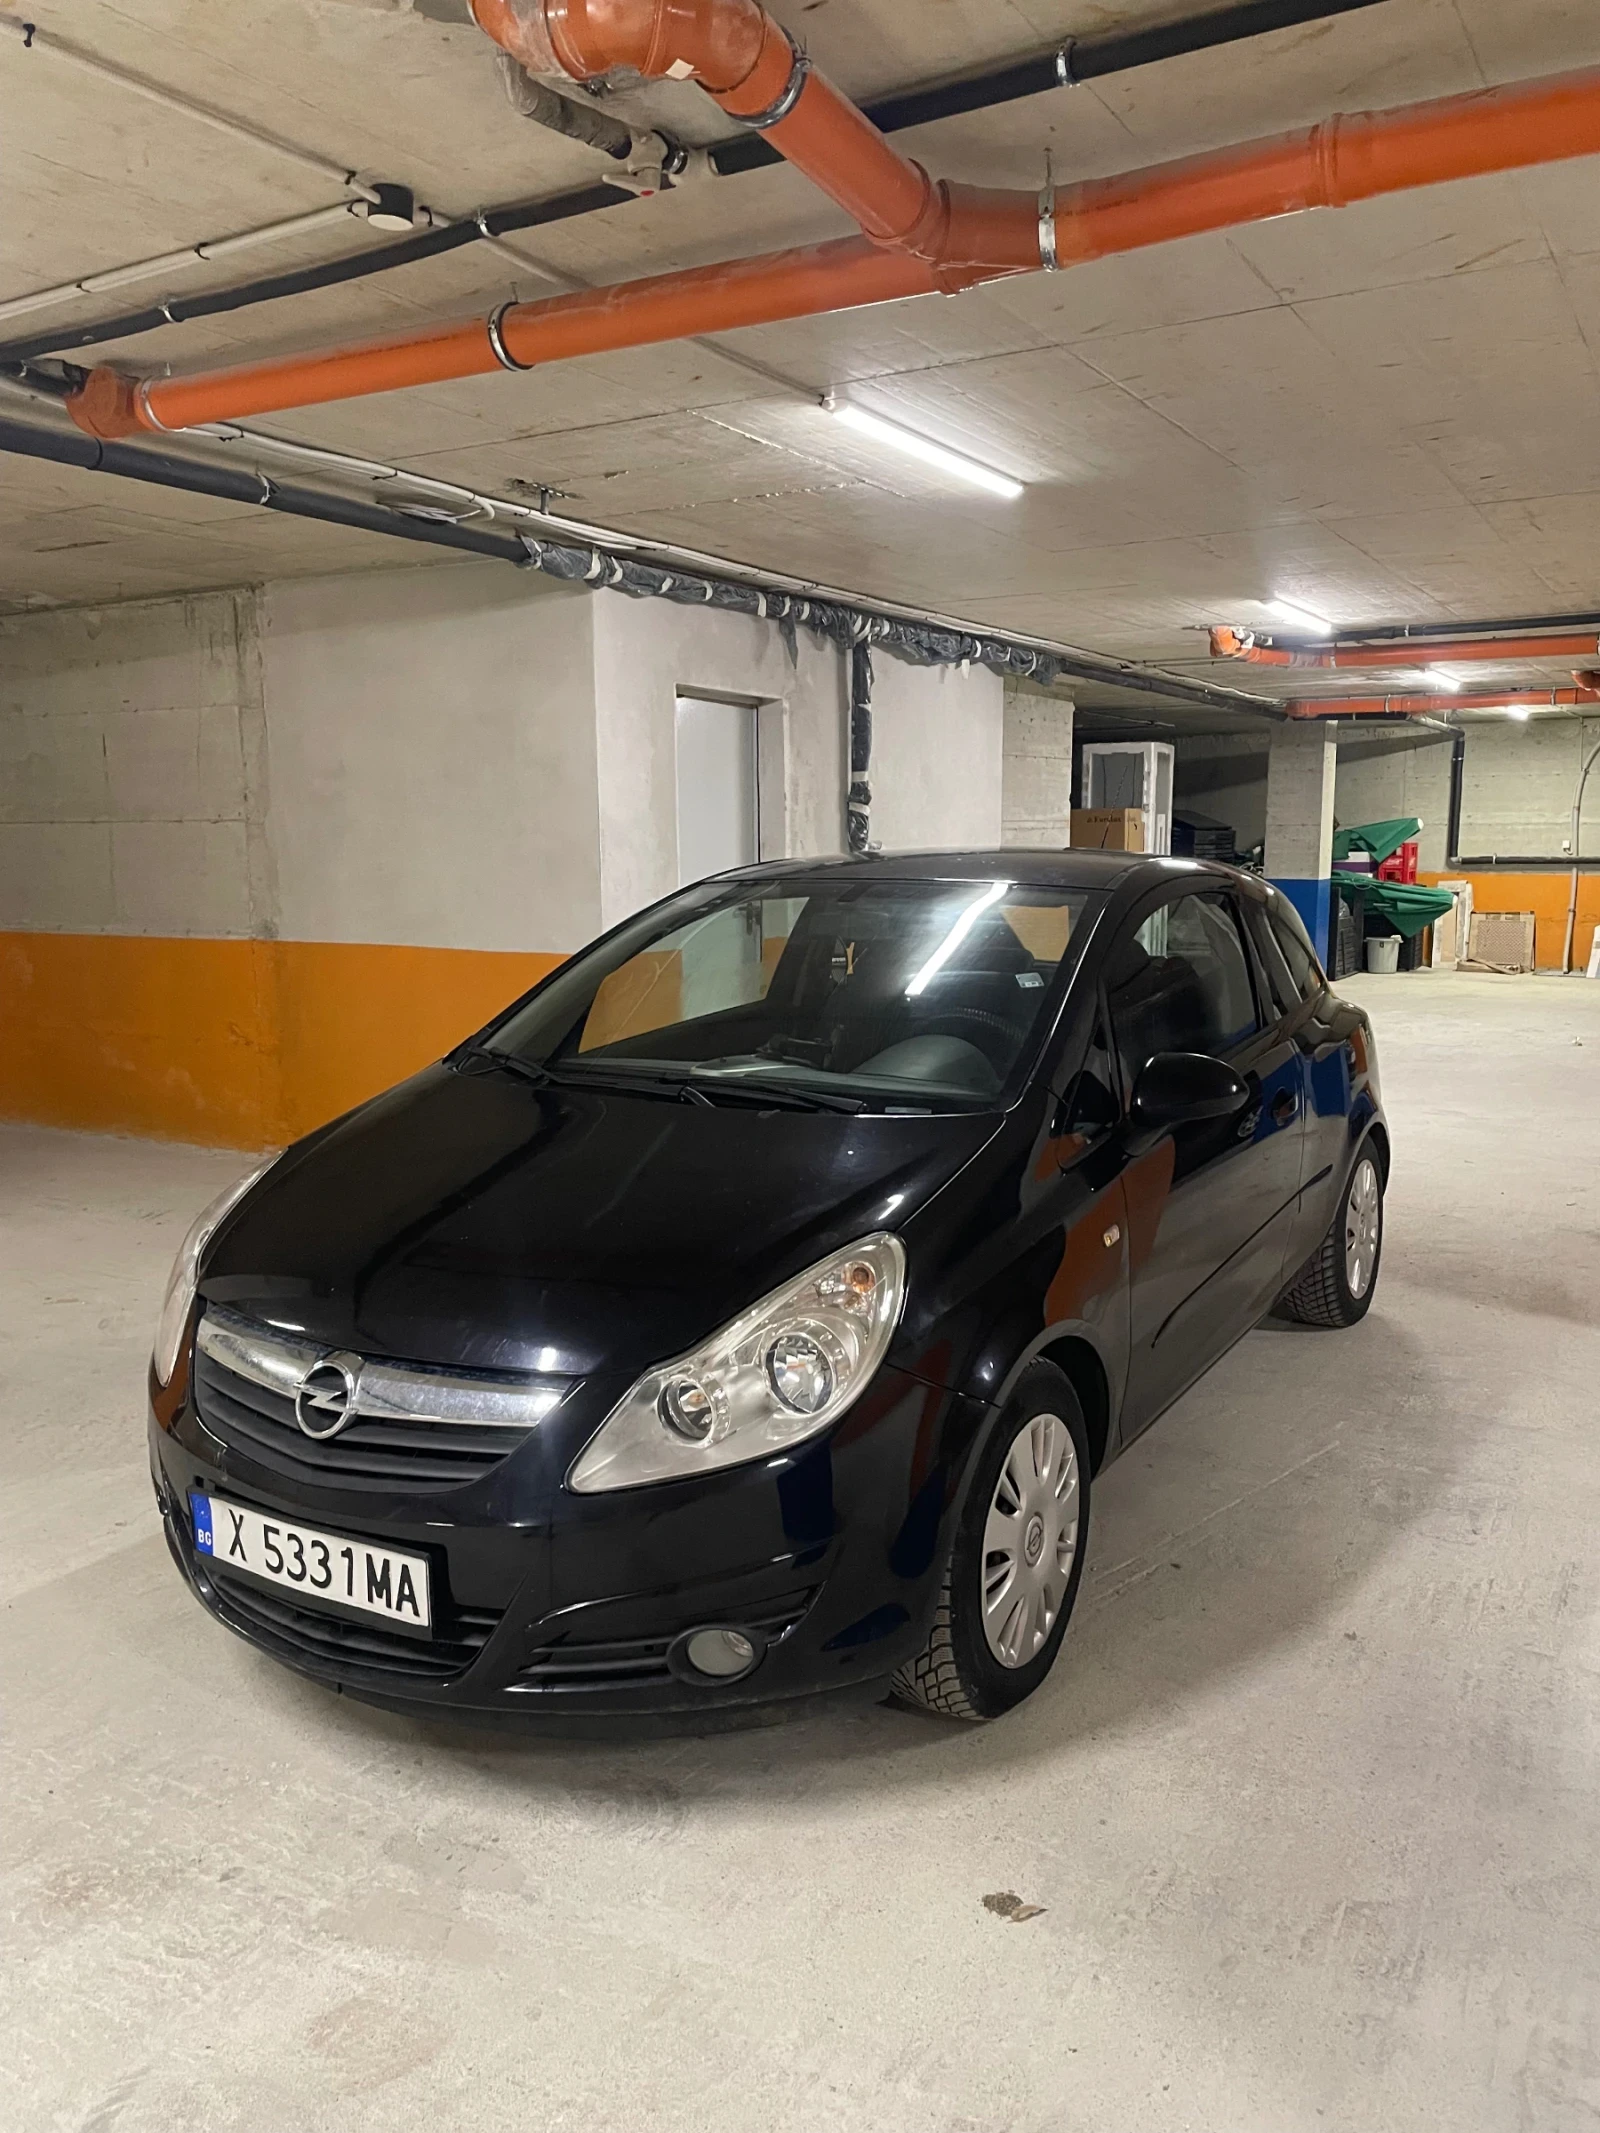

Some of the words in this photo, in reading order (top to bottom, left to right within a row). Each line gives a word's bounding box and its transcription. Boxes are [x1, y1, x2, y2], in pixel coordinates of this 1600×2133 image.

[198, 1529, 212, 1546] BG
[229, 1509, 247, 1562] X
[264, 1524, 420, 1617] 5331MA
